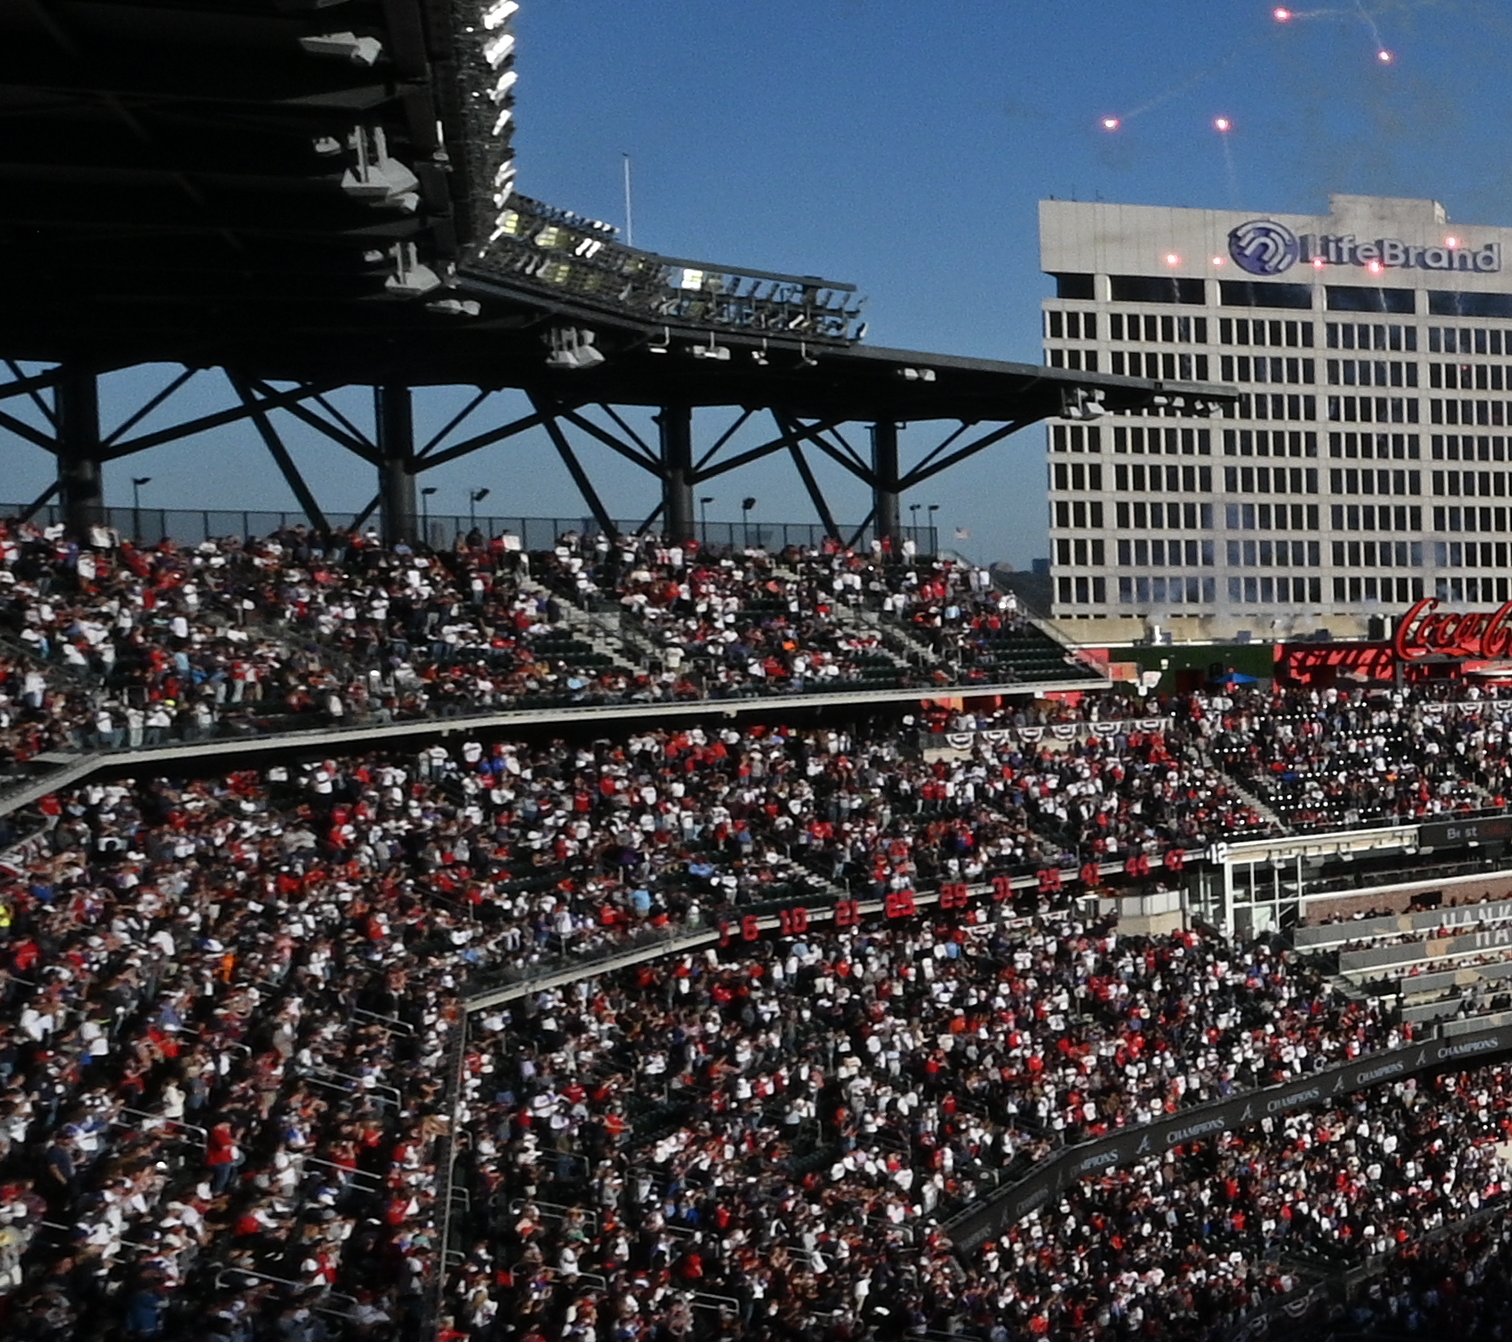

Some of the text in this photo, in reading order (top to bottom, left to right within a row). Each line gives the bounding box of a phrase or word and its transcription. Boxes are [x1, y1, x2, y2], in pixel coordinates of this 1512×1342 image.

[1303, 234, 1501, 272] LifeBrand
[1125, 855, 1150, 878] 44
[886, 892, 916, 919] 25
[940, 883, 969, 910] 29
[780, 908, 808, 936] 10
[835, 900, 862, 926] 21
[740, 915, 759, 942] 6
[1166, 1116, 1226, 1144] CHAMPIONS
[1267, 1087, 1321, 1113] CHAMPIONS
[1357, 1062, 1405, 1085] CHAMPIONS
[1437, 1036, 1499, 1059] CHAMPIONS
